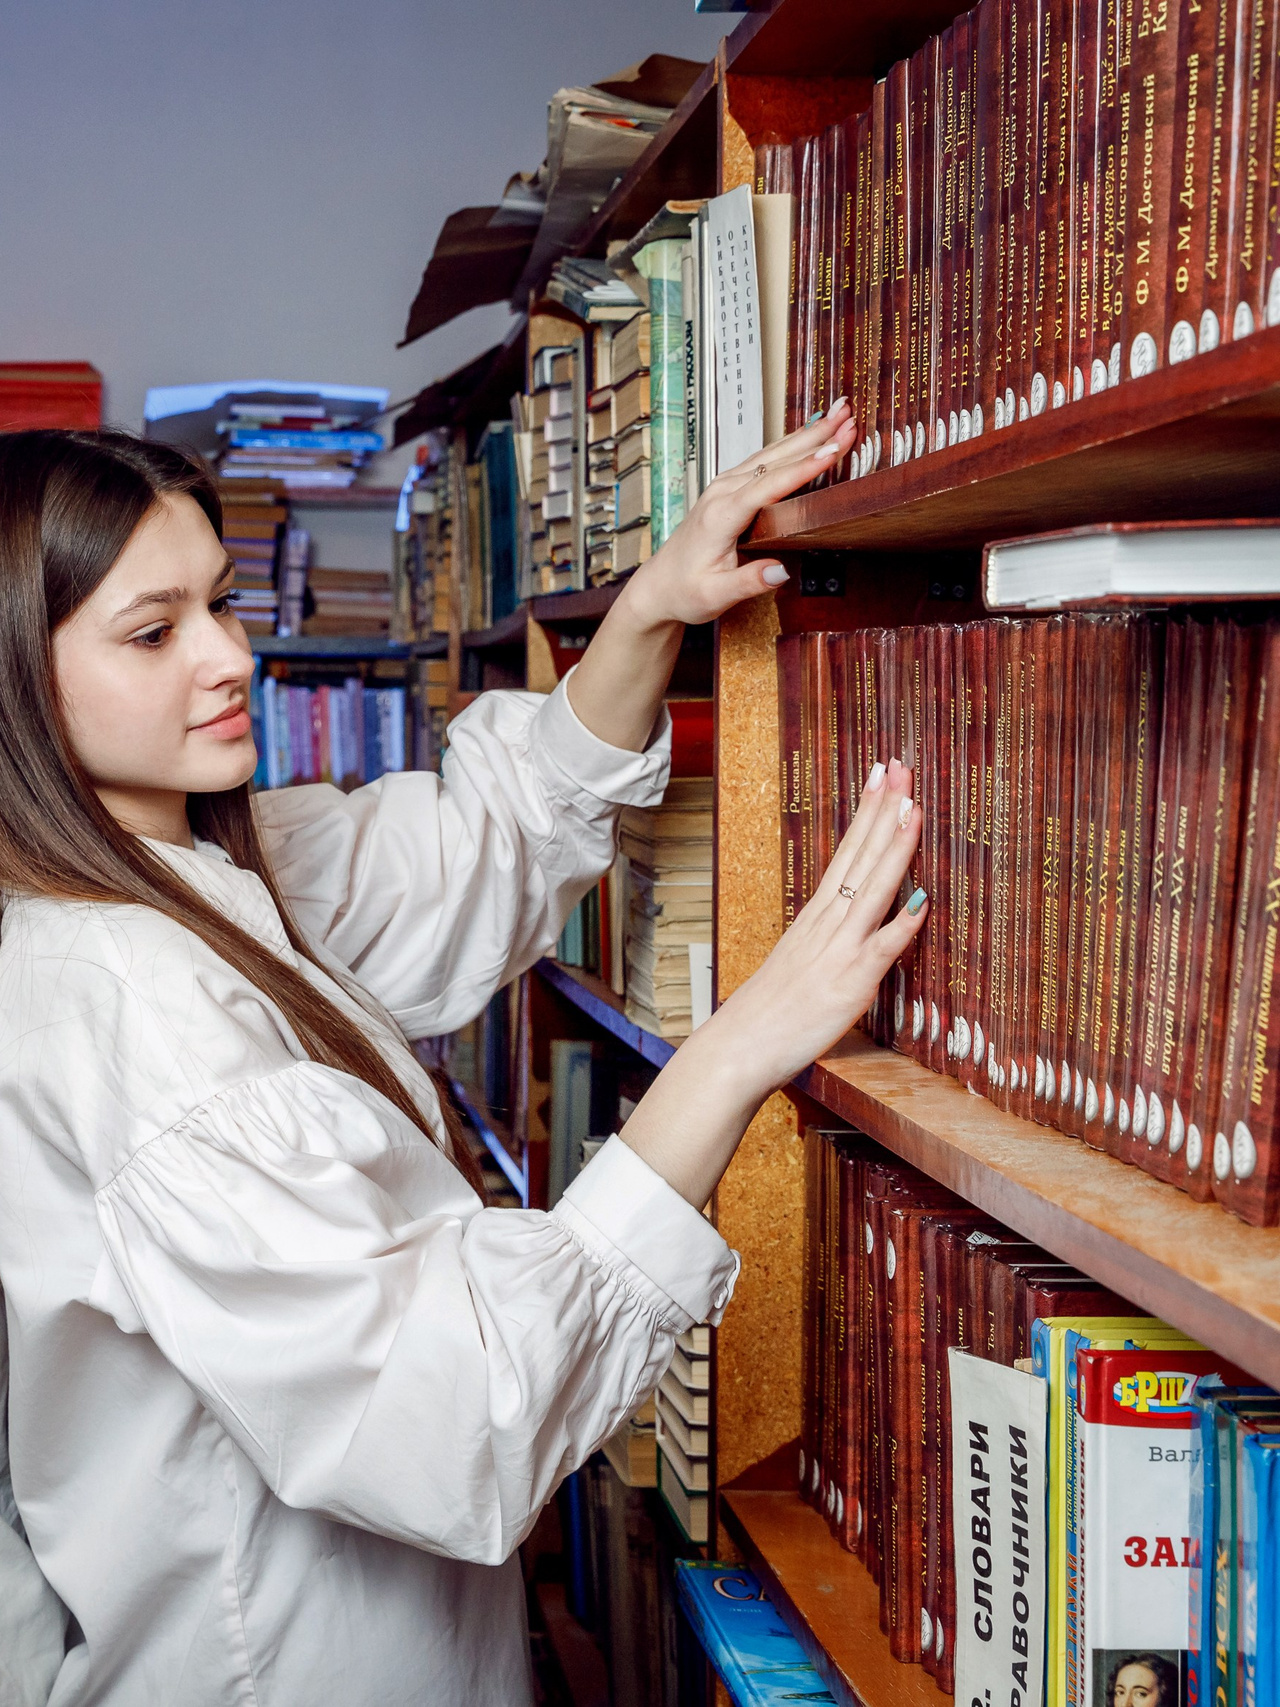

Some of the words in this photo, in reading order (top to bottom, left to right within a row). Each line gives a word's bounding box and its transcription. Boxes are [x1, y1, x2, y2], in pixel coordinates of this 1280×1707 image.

[1009, 3, 1017, 106] «Паллада»
[1041, 11, 1051, 80] Пьесы
[1108, 35, 1114, 55] от
[1123, 20, 1133, 66] Белые
[944, 67, 953, 154] Миргород
[1059, 42, 1068, 119] Гордеев
[957, 90, 966, 146] Пьесы
[1039, 101, 1049, 195] Рассказы
[1137, 73, 1155, 225] Достоевский
[1179, 53, 1199, 209] Достоевский
[894, 122, 904, 195] Рассказы
[978, 146, 986, 211] Обрыв
[1058, 126, 1067, 185] Фома
[1116, 91, 1131, 235] Достоевский
[1204, 136, 1222, 279] Драматургия
[1214, 53, 1226, 129] второй
[1239, 88, 1258, 271] Древнерусская
[844, 192, 852, 247] Мольер
[857, 152, 865, 226] Маргарита
[872, 188, 880, 230] аллеи
[942, 163, 953, 250] Диканьки.
[1080, 181, 1090, 234] прозе
[871, 234, 880, 287] Темные
[883, 226, 891, 280] Темные
[896, 214, 906, 280] Повести
[1007, 214, 1015, 302] Гончаров
[1056, 220, 1065, 303] Горький
[1082, 239, 1088, 251] и
[1136, 231, 1151, 264] М.
[1176, 216, 1191, 251] М.
[742, 225, 754, 345] КЛАССИКИ
[822, 256, 832, 310] Поэмы
[854, 251, 863, 296] Мастер
[923, 267, 932, 311] прозе
[963, 268, 972, 329] Гоголь
[975, 234, 984, 317] Гончаров
[996, 223, 1006, 312] Гончаров
[1021, 244, 1030, 324] Горький
[1035, 230, 1046, 312] Горький
[1079, 257, 1091, 321] лирике
[1136, 271, 1150, 305] Ф.
[1175, 258, 1190, 293] Ф.
[716, 235, 729, 383] БИБЛИОТЕКА
[728, 230, 743, 425] ОТЕЧЕСТВЕННОЙ
[893, 311, 902, 360] Бунин
[1034, 318, 1043, 347] М.
[1054, 311, 1063, 339] М.
[684, 320, 693, 388] РАССКАЗЫ
[909, 336, 918, 386] лирике
[922, 331, 931, 383] лирике
[685, 399, 695, 461] ПОВЕСТИ
[1137, 717, 1145, 754] XX
[789, 750, 800, 813] Рассказы
[1135, 758, 1145, 849] половины
[1087, 822, 1095, 859] века
[1102, 829, 1110, 866] века
[1118, 829, 1126, 867] века
[1157, 801, 1167, 844] века
[1176, 805, 1188, 850] века
[785, 839, 795, 897] Набоков
[961, 875, 970, 949] Распутин
[967, 764, 978, 843] Рассказы
[977, 878, 985, 954] Распутин
[982, 765, 993, 846] Рассказы
[1043, 852, 1053, 892] XIX
[1084, 861, 1094, 901] XIX
[1130, 853, 1140, 915] второй
[1153, 849, 1164, 897] XIX
[1170, 853, 1185, 905] XIX
[1013, 866, 1022, 965] литературная
[1098, 867, 1108, 910] XIX
[1115, 869, 1125, 911] XIX
[1043, 896, 1053, 973] половины
[1081, 904, 1091, 983] половины
[1096, 913, 1106, 993] половины
[1111, 914, 1122, 995] половины
[1149, 901, 1161, 997] половины
[1167, 909, 1181, 1005] половины
[1040, 975, 1052, 1030] первой
[1256, 925, 1277, 1029] половины
[1079, 985, 1088, 1041] второй
[1093, 995, 1103, 1052] второй
[1109, 999, 1120, 1056] второй
[1143, 1000, 1156, 1067] первой
[1161, 1008, 1176, 1075] второй
[1222, 1035, 1236, 1099] Русская
[1250, 1032, 1269, 1105] второй
[1018, 1326, 1023, 1335] 2
[888, 1438, 897, 1482] Рудин
[890, 1497, 898, 1578] Дворянское
[969, 1420, 993, 1642] СЛОВАРИ
[921, 1564, 927, 1586] А.
[1067, 1549, 1077, 1645] НАУКИ
[1216, 1543, 1227, 1676] ВСЕХ
[1067, 1648, 1077, 1706] МИР
